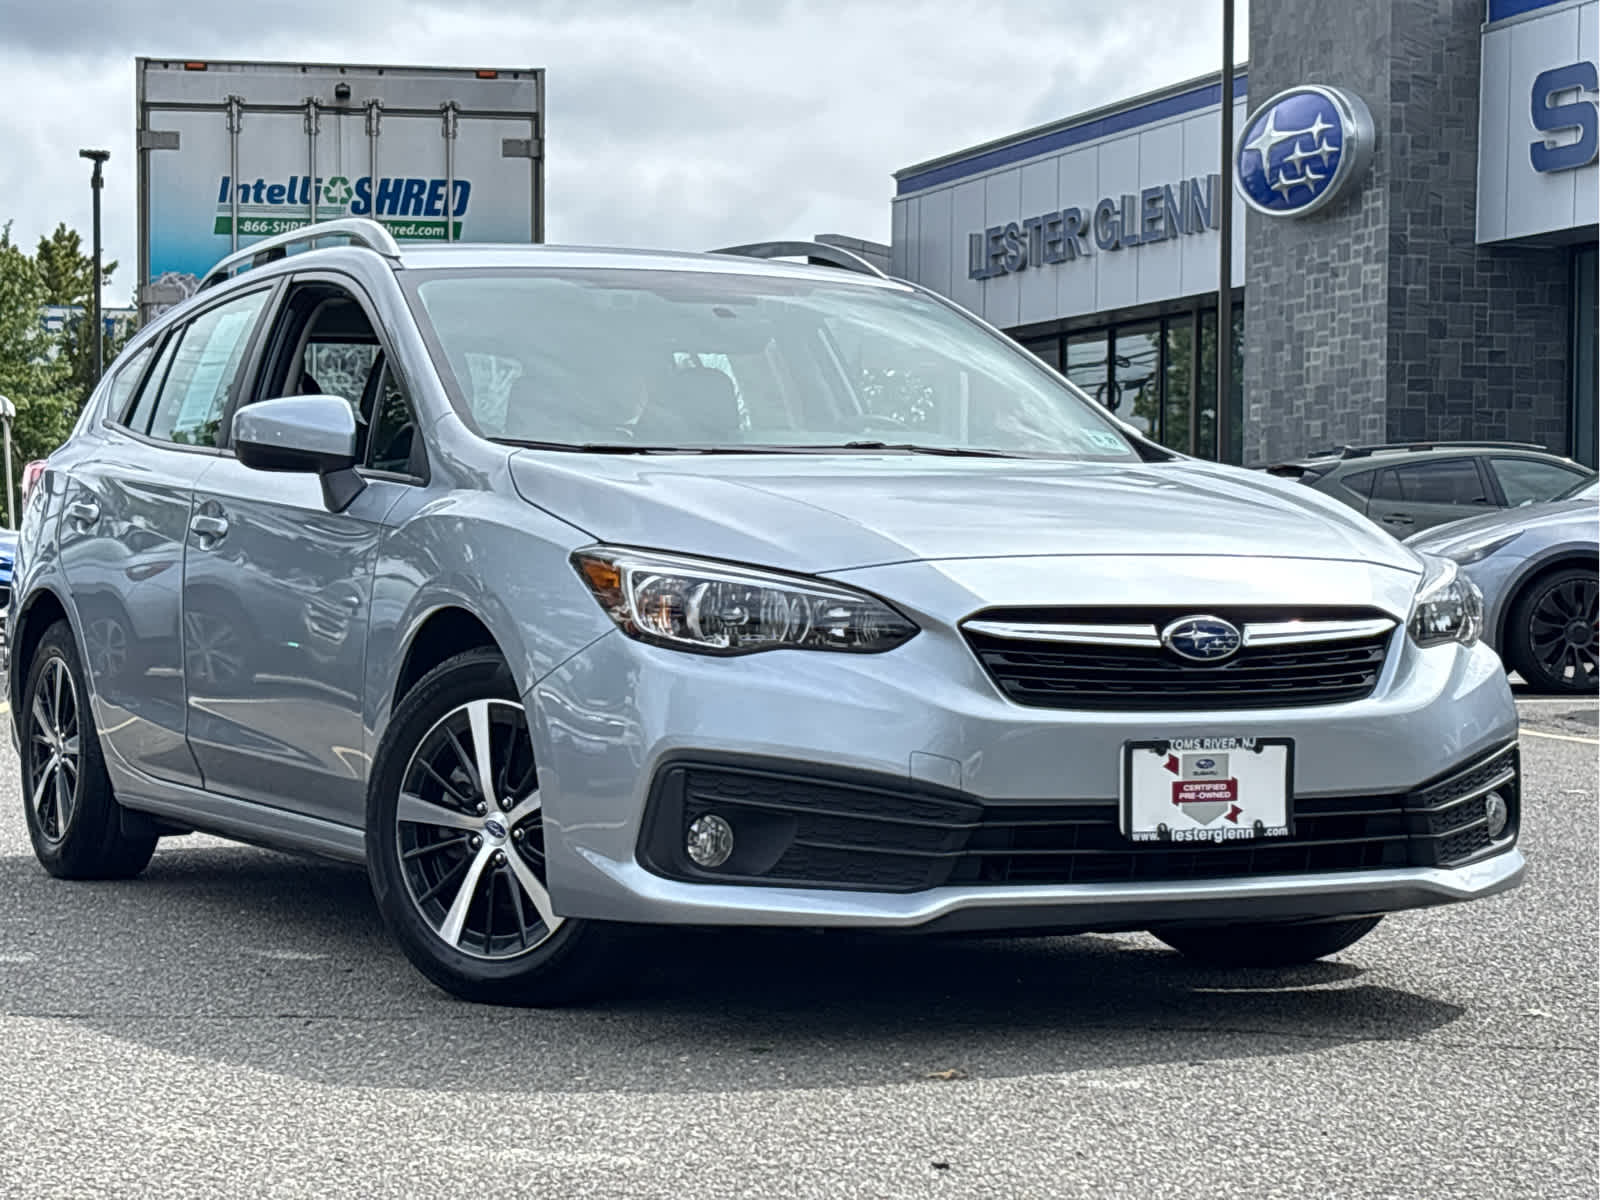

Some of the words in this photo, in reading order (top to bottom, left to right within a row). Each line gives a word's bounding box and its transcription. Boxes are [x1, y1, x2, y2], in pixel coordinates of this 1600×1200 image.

[383, 223, 445, 236] hred.com
[969, 207, 1090, 280] LESTER
[1093, 174, 1220, 251] GLENN
[1169, 739, 1201, 750] TOMS
[1242, 737, 1257, 748] NJ
[1183, 783, 1227, 792] CERTIFIED
[1179, 791, 1231, 800] PRE-OWNED
